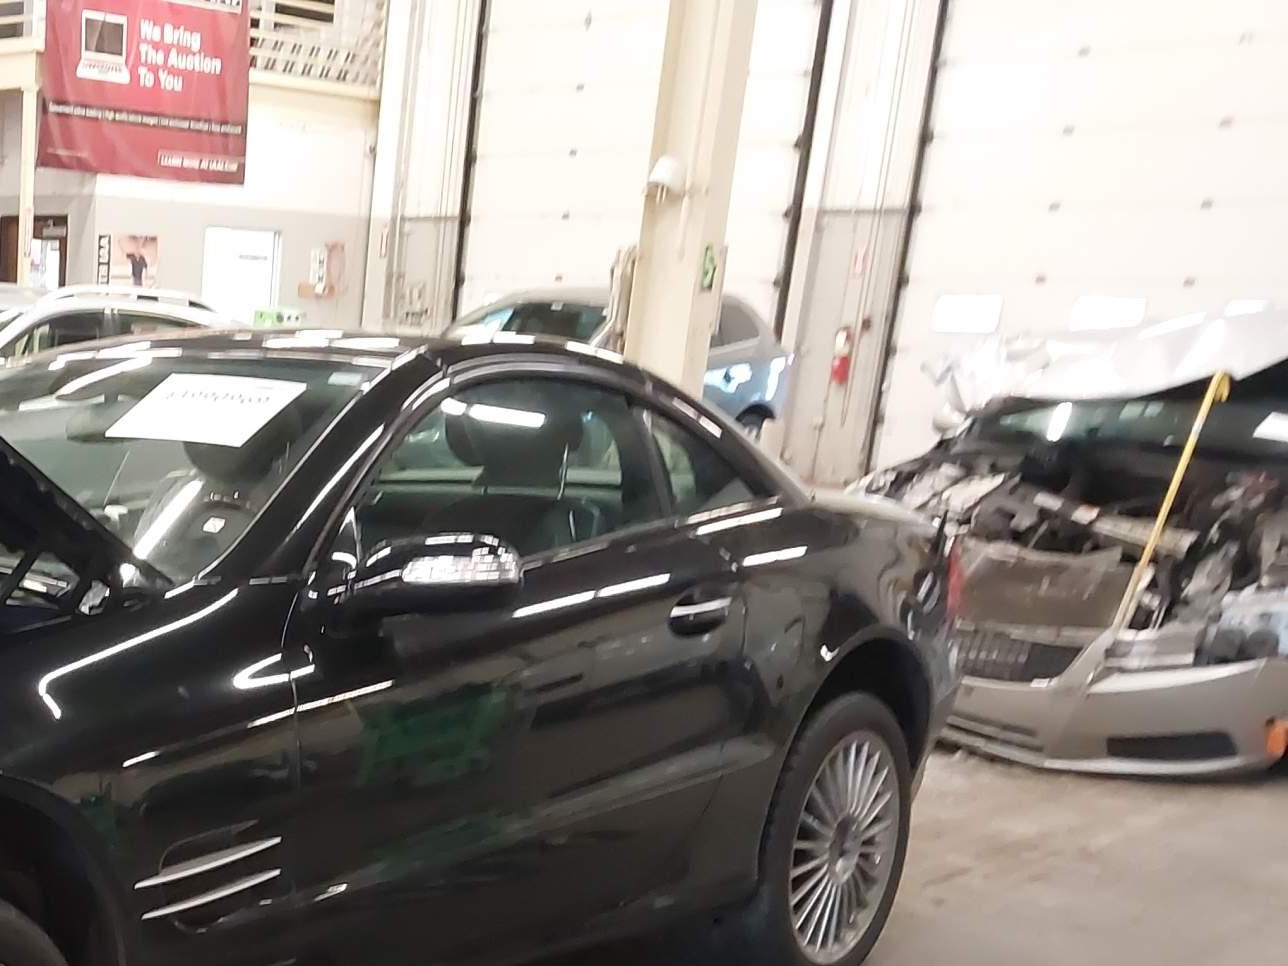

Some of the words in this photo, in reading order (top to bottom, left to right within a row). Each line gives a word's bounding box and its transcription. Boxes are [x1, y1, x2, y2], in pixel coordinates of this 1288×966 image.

[140, 19, 161, 42] We
[164, 24, 201, 51] Bring
[138, 43, 163, 66] The
[168, 48, 222, 75] Auction
[138, 66, 154, 88] To
[159, 69, 183, 92] You
